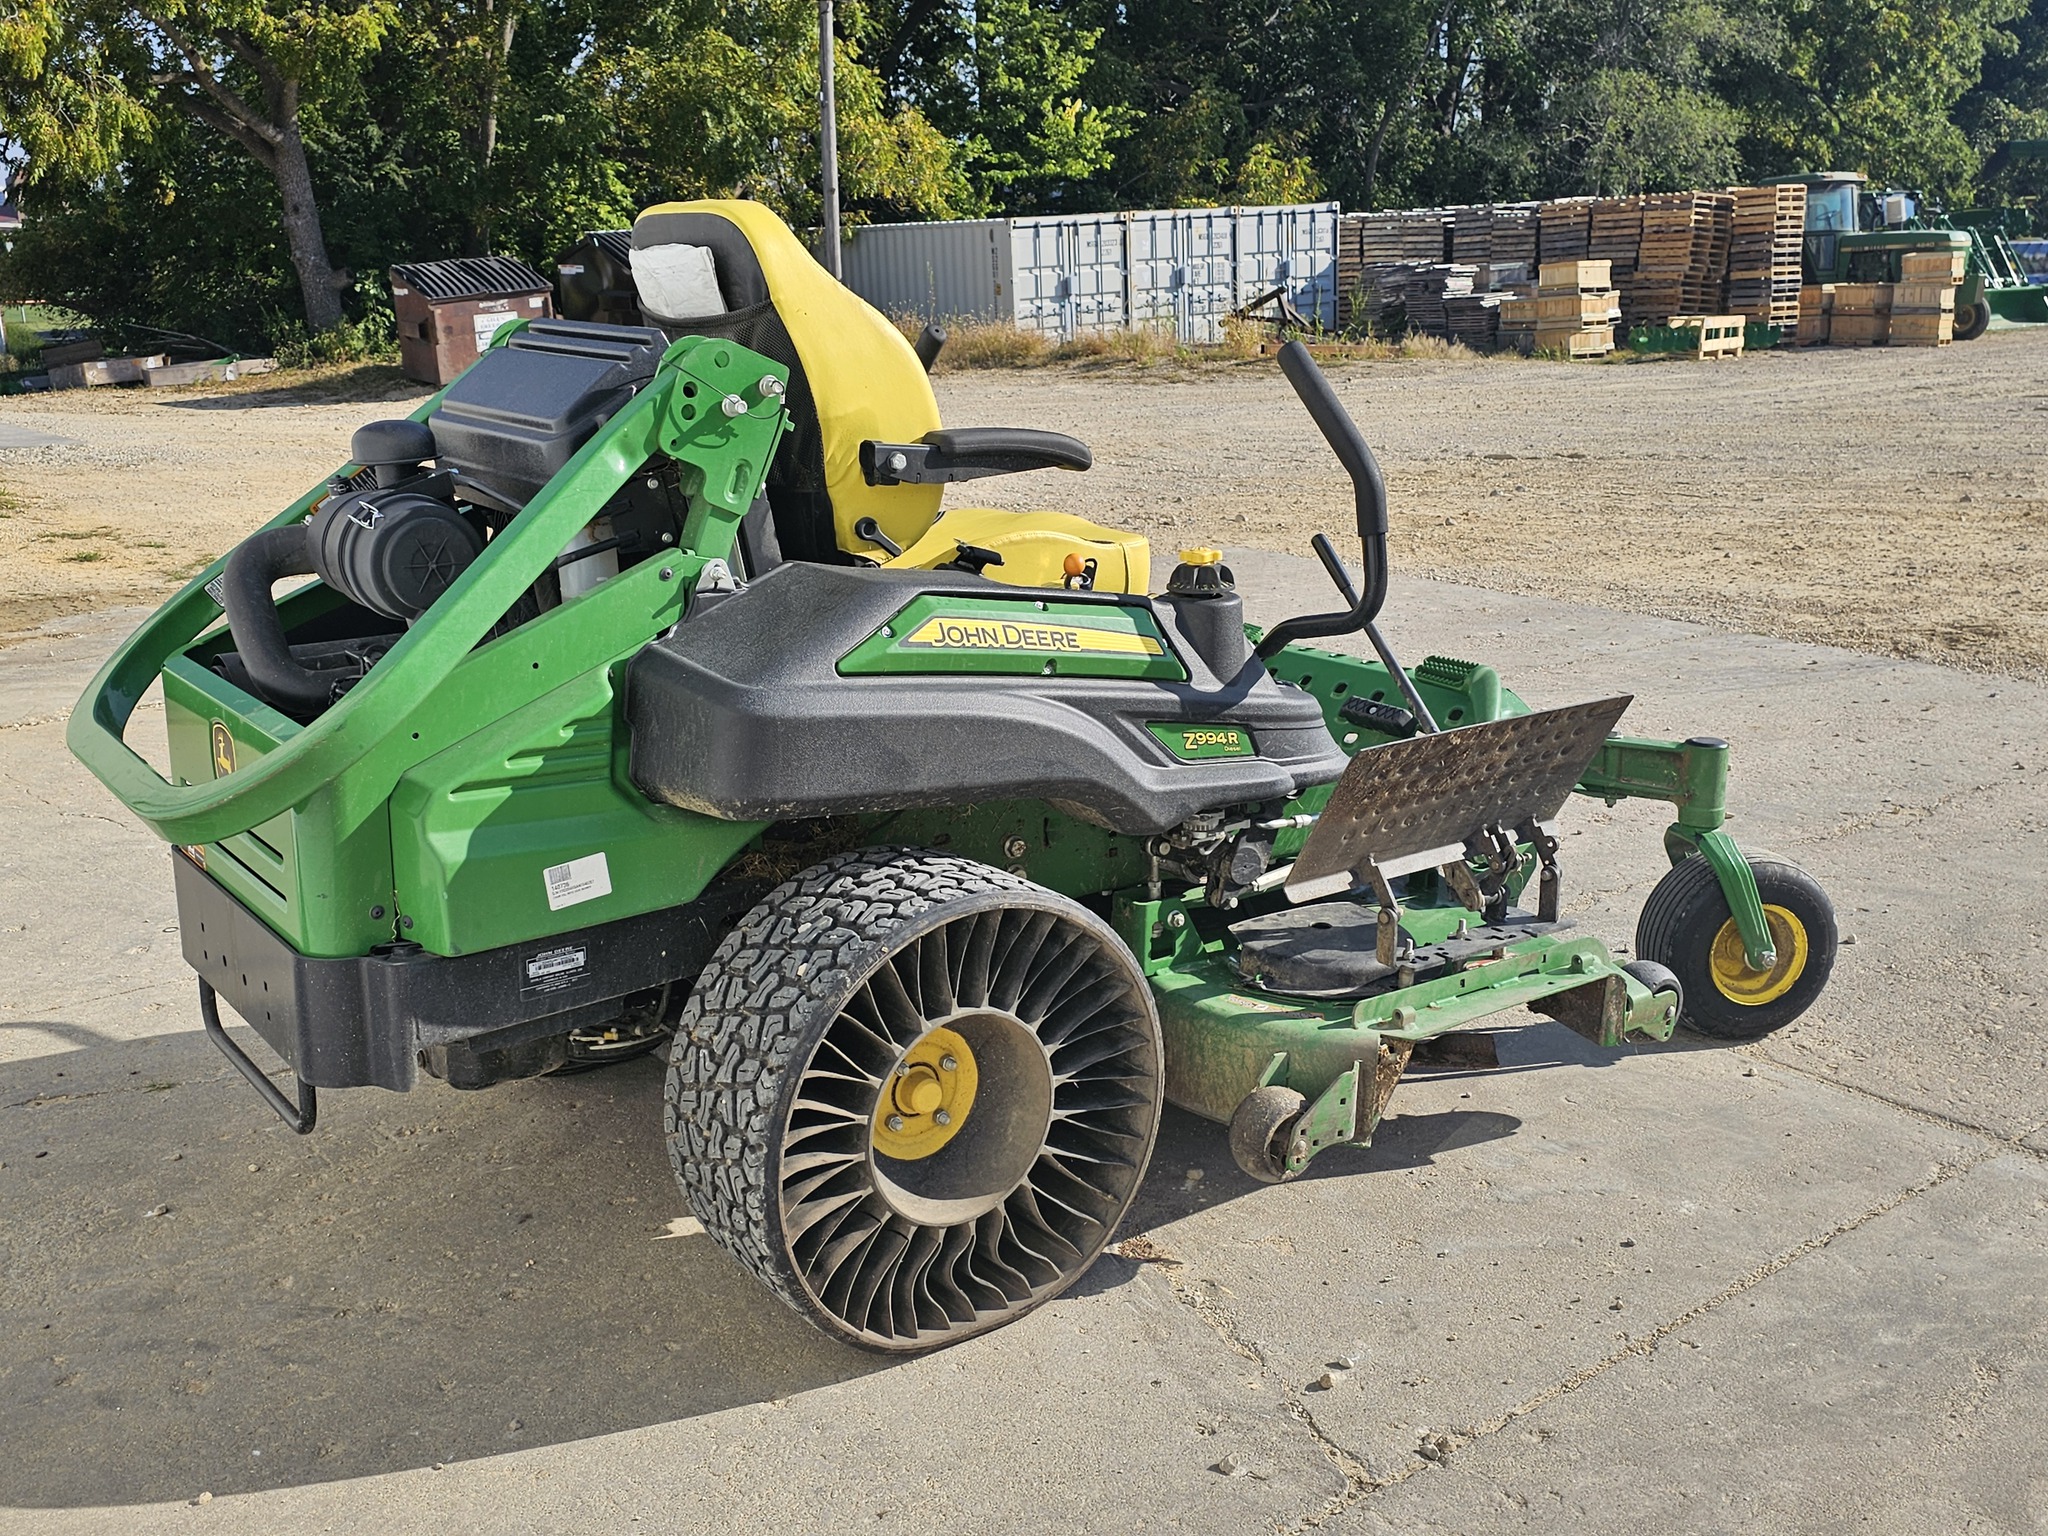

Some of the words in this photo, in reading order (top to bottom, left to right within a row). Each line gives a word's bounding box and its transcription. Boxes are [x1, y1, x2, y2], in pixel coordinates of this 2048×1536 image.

[934, 622, 999, 645] JOHN
[1002, 624, 1081, 649] DEERE
[1183, 732, 1239, 750] Z994R
